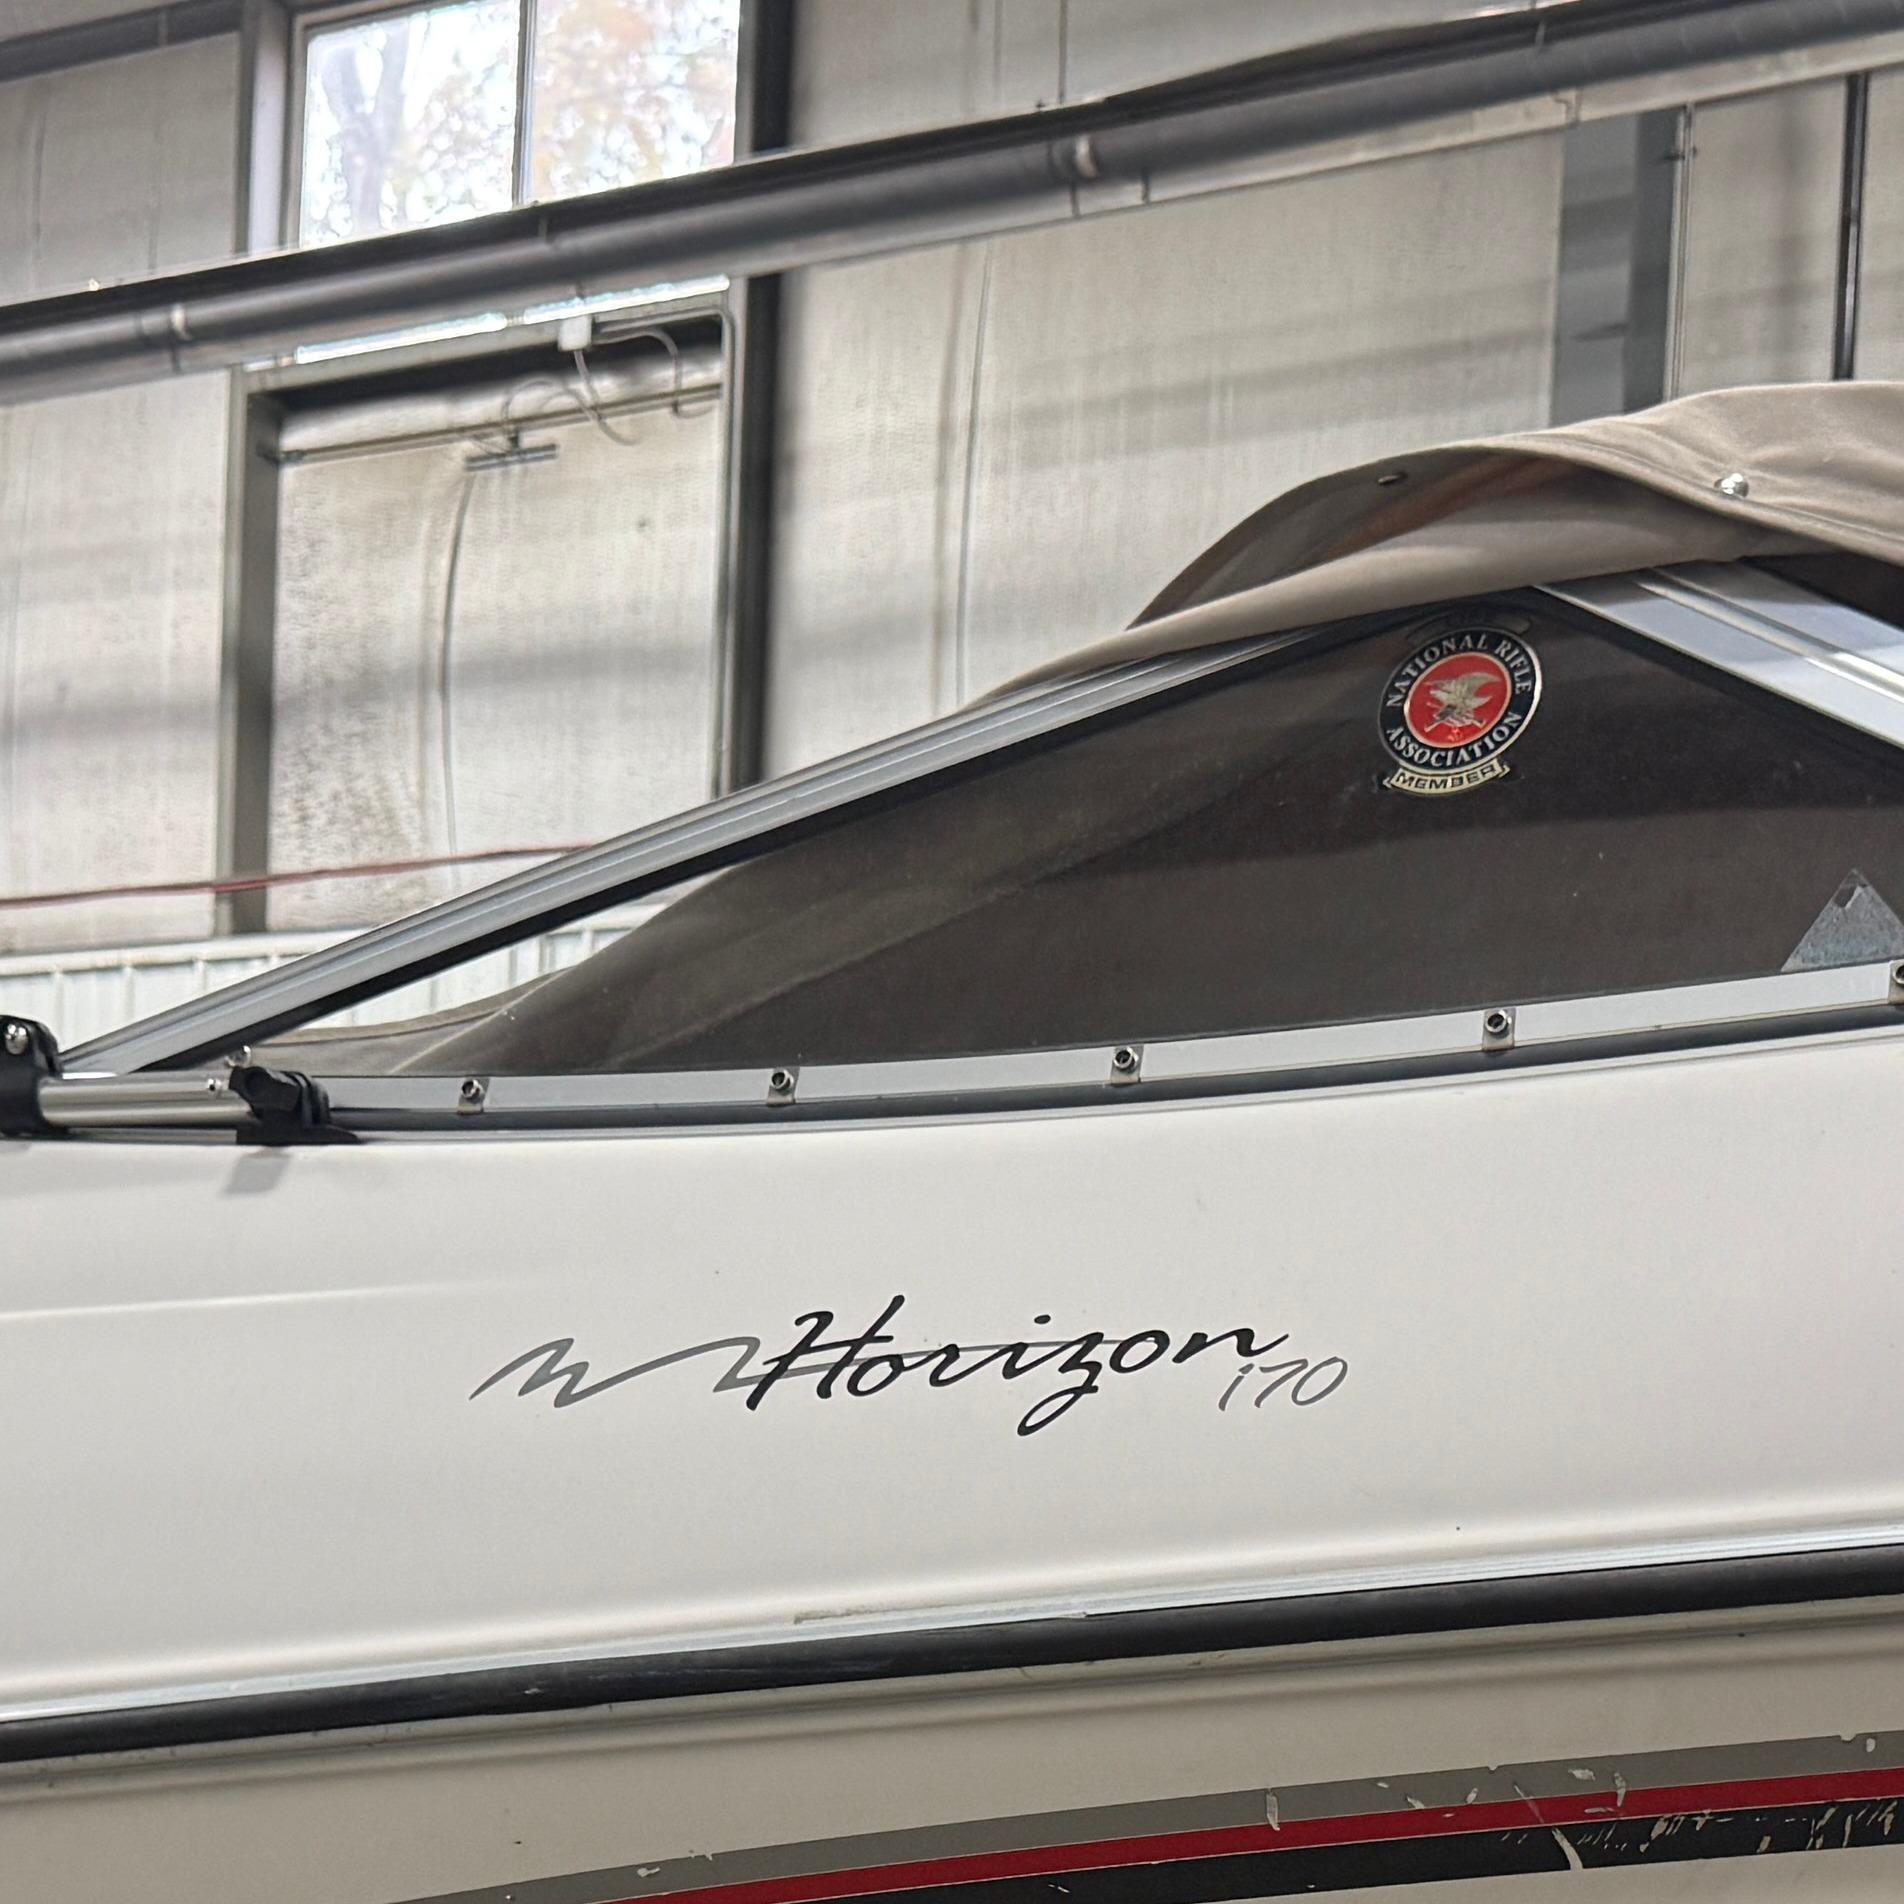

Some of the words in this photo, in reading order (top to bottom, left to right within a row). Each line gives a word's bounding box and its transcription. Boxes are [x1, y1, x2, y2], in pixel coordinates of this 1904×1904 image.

[1386, 633, 1489, 708] NATIONAL
[1494, 638, 1533, 695] RIFLE
[1386, 711, 1523, 767] ASSOCIATION
[1396, 763, 1496, 790] MEMBER
[745, 1294, 1289, 1437] Horizon
